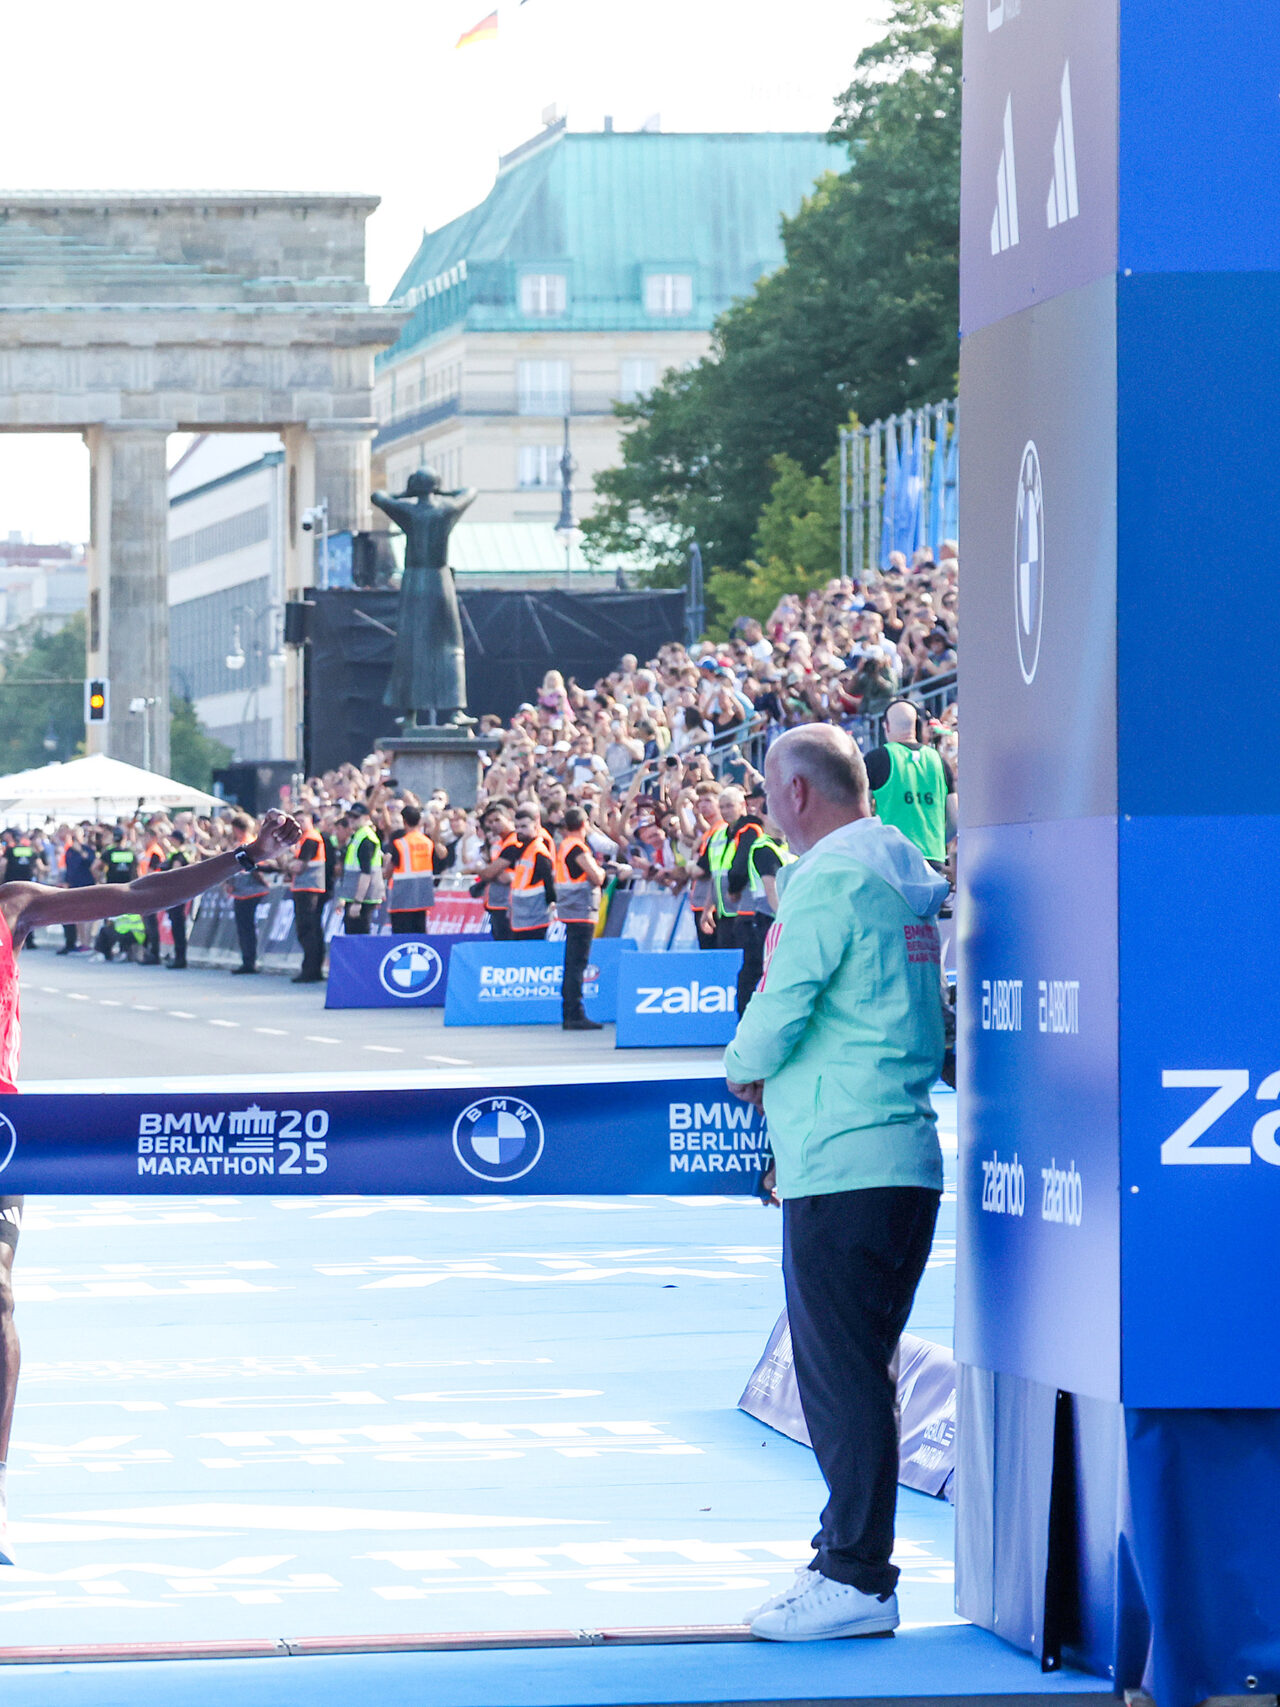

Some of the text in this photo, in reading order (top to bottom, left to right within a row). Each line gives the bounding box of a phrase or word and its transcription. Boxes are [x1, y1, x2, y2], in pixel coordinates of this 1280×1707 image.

[904, 791, 934, 805] 616
[480, 966, 563, 985] ERDINGE
[478, 982, 599, 999] ALKOHOLEI
[466, 1100, 531, 1122] BMW
[669, 1103, 754, 1129] BMW
[138, 1112, 225, 1135] BMW
[280, 1110, 329, 1139] 20
[138, 1136, 225, 1154] BERLIN
[670, 1132, 755, 1150] BERLIN
[137, 1156, 275, 1175] MARATHON
[279, 1142, 328, 1174] 25
[670, 1154, 753, 1172] MARAT
[982, 1150, 1025, 1217] zalando
[1041, 1157, 1082, 1227] zalando
